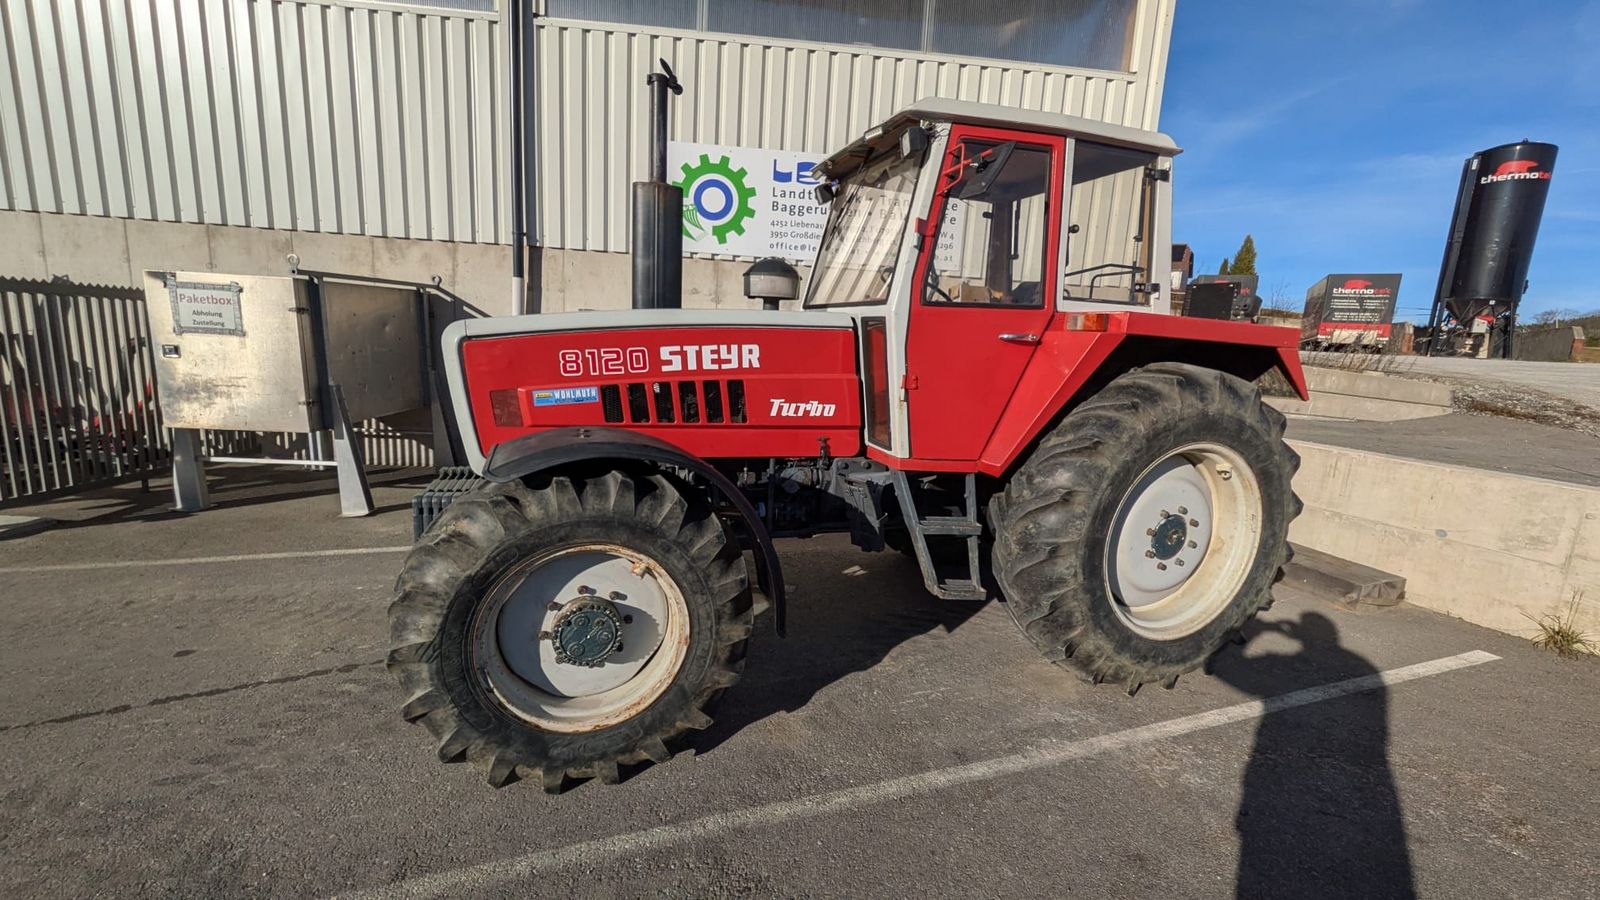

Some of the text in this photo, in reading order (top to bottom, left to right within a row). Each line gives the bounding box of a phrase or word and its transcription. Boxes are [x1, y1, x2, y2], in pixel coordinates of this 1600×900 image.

[770, 220, 788, 228] 4252
[770, 231, 788, 239] 3950
[790, 231, 821, 240] Großdie
[769, 242, 817, 252] office@le
[179, 293, 232, 306] Paketbox
[192, 309, 223, 318] Abholung
[192, 319, 225, 328] Zustellung
[559, 344, 761, 377] 8120 STEYR
[769, 398, 836, 417] Turbo
